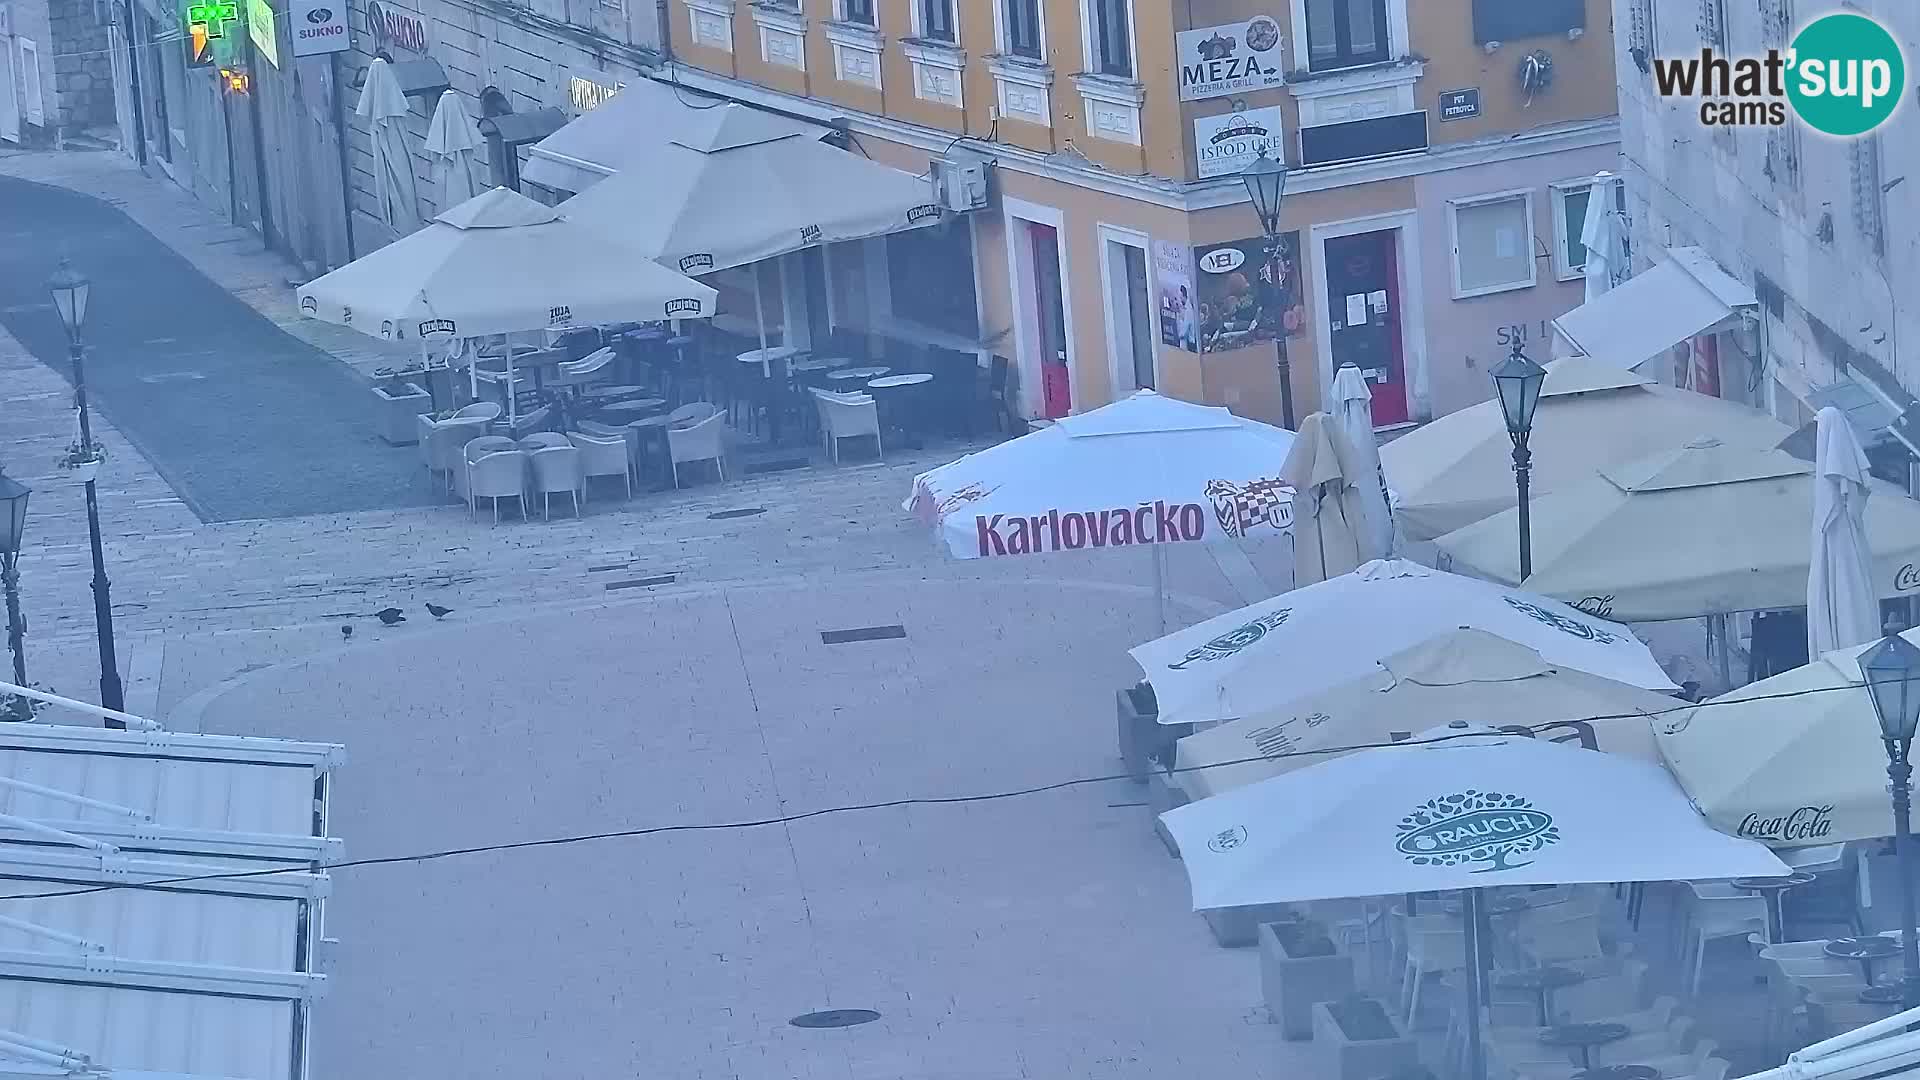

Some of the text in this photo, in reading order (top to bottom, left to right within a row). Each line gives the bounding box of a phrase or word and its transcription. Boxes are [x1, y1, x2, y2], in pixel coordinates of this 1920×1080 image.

[299, 25, 343, 39] SUKNO
[385, 9, 425, 50] SUKNO
[1183, 56, 1261, 86] MEZA
[1192, 82, 1225, 94] PIZZERIA
[1232, 79, 1254, 88] GRILL
[1445, 103, 1476, 116] PETROVCA
[1453, 95, 1465, 104] PUT
[1201, 135, 1281, 160] ISPOD URE
[800, 224, 820, 238] ŽUJA
[550, 305, 570, 318] ŽUJA
[975, 500, 1205, 557] Karlovačko
[1435, 814, 1535, 846] RAUCH
[1737, 804, 1835, 841] Coca-Cola
